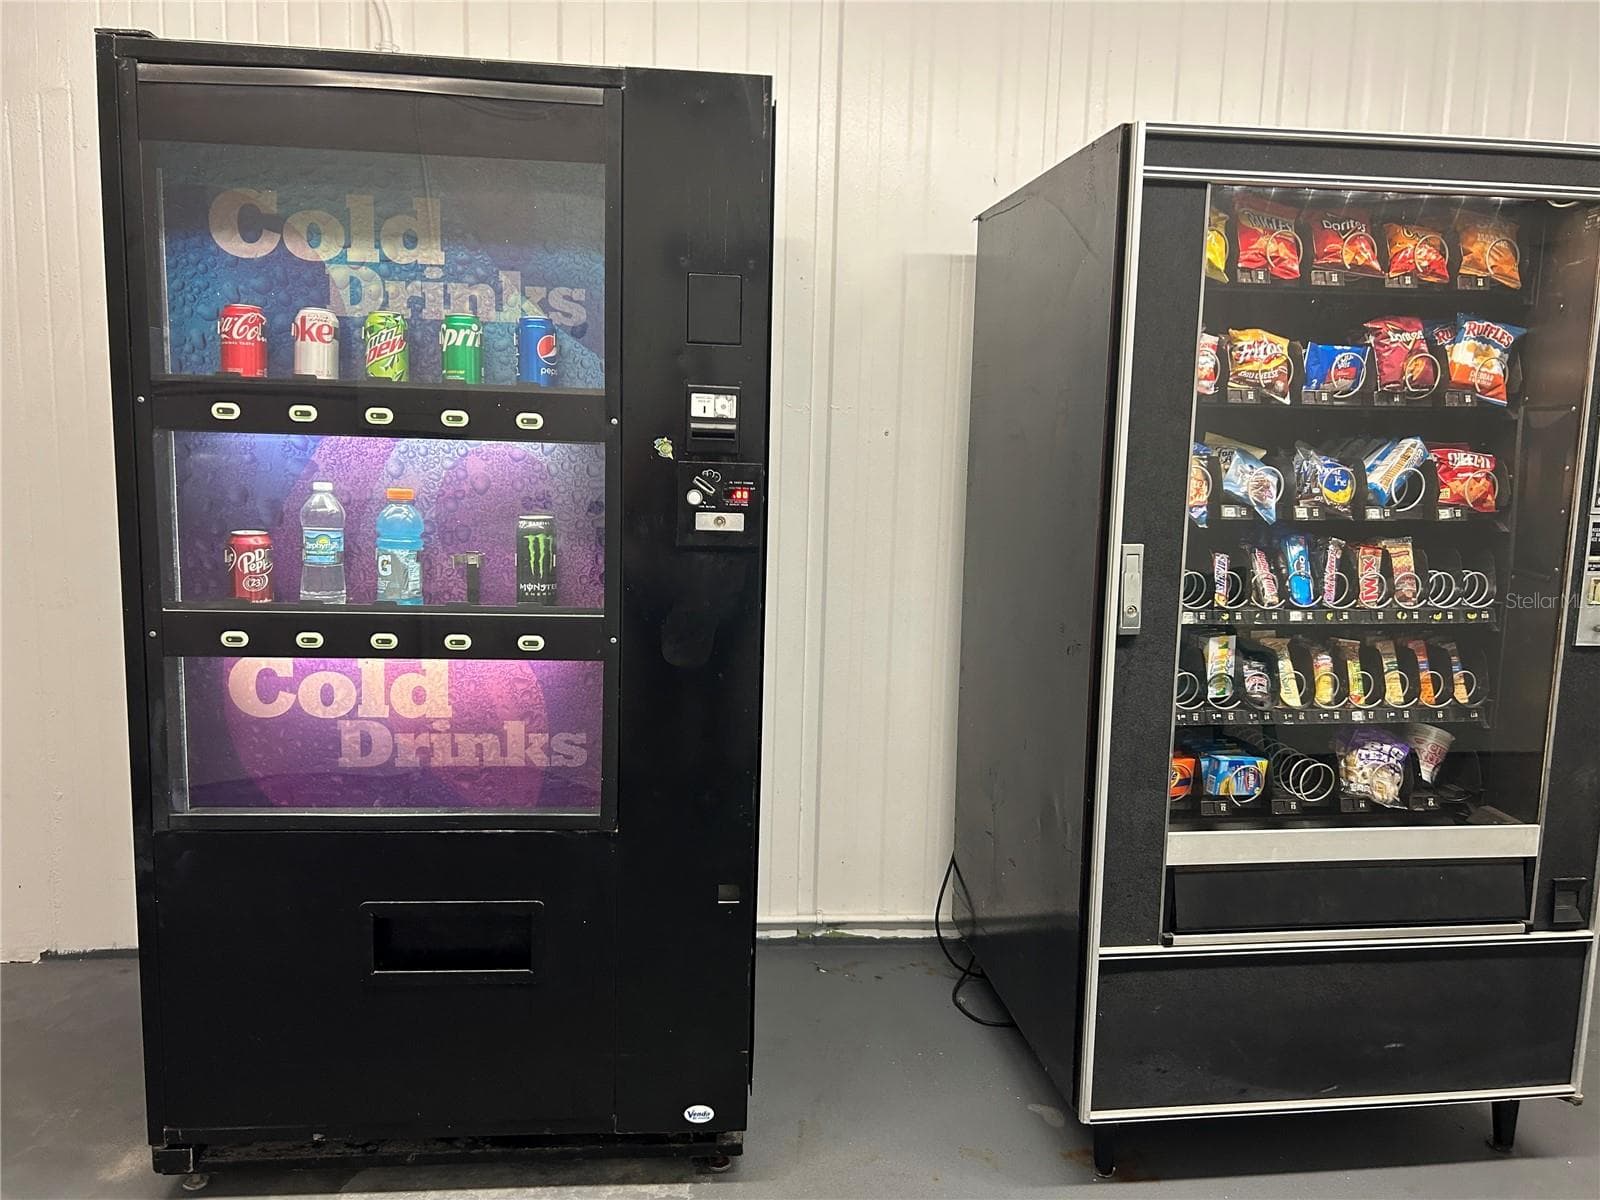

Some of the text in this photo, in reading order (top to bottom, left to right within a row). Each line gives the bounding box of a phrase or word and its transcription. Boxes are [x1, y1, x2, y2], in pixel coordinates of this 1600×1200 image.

[209, 188, 445, 265] Cold
[326, 264, 588, 327] Drinks
[1465, 322, 1513, 348] RUFFLES
[378, 554, 391, 576] G
[1361, 558, 1378, 601] TWX
[228, 657, 452, 718] Cold
[338, 720, 588, 767] Drinks
